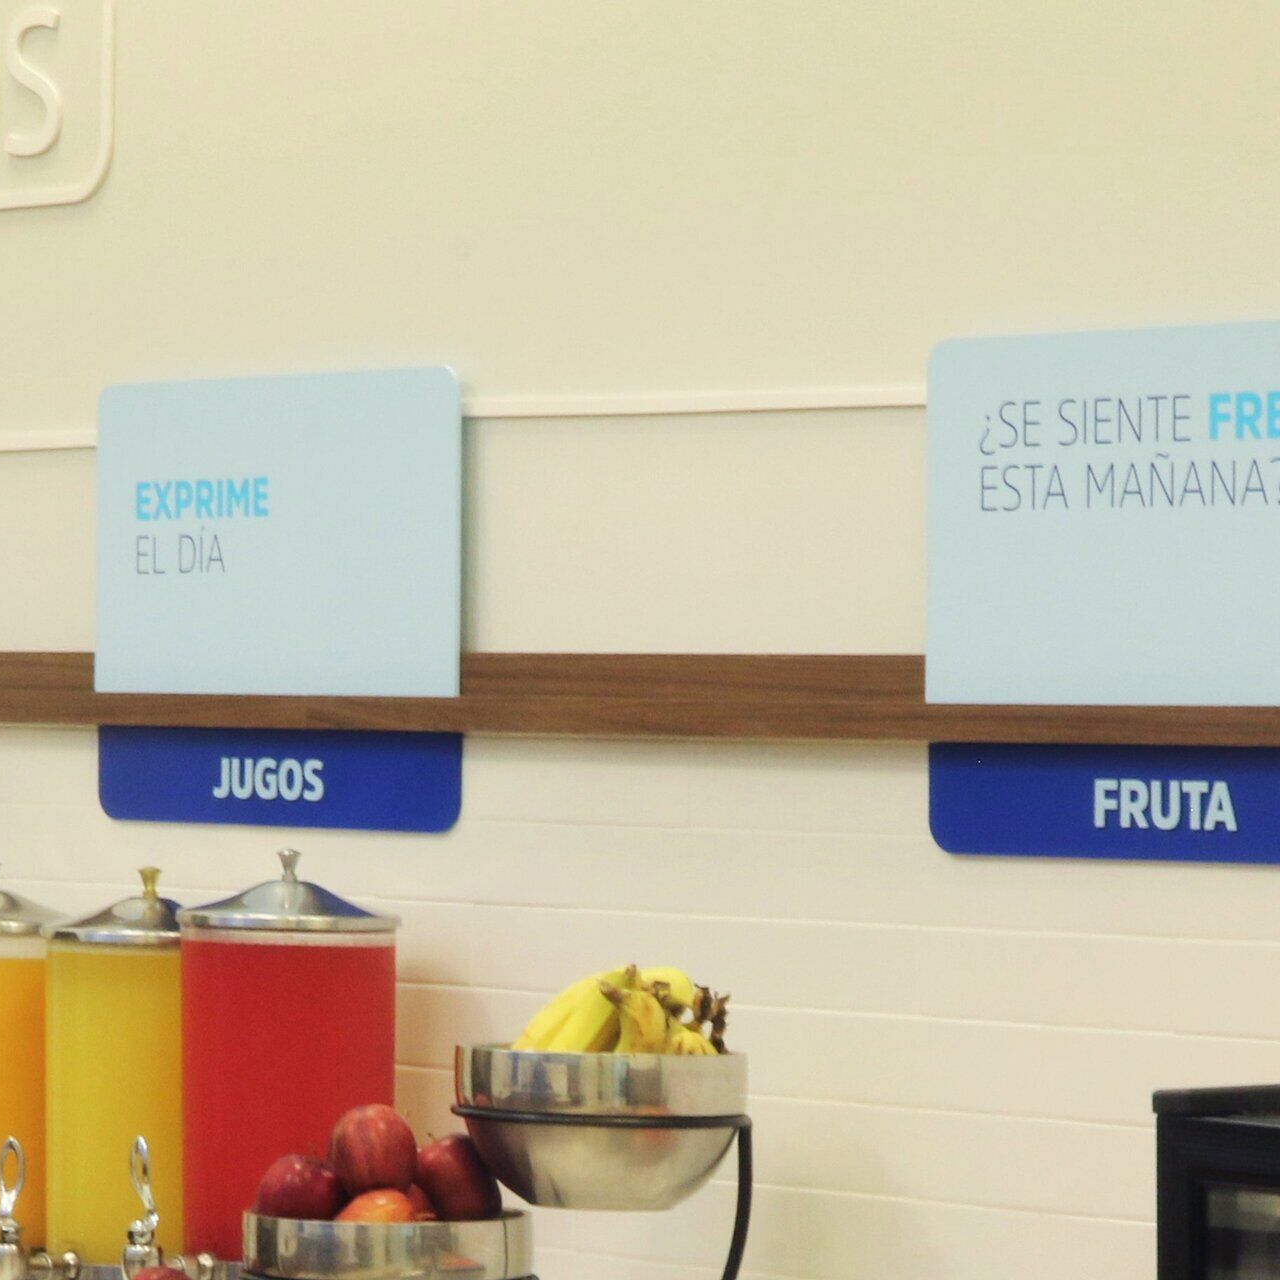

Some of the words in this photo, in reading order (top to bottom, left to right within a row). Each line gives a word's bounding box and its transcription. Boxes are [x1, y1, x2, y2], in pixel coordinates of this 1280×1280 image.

[978, 400, 1042, 457] ¿SE
[1058, 395, 1192, 447] SIENTE
[135, 476, 269, 521] EXPRIME
[980, 463, 1069, 512] ESTA
[136, 534, 166, 575] EL
[178, 525, 226, 574] DÍA
[212, 757, 325, 802] JUGOS
[1093, 778, 1238, 831] FRUTA
